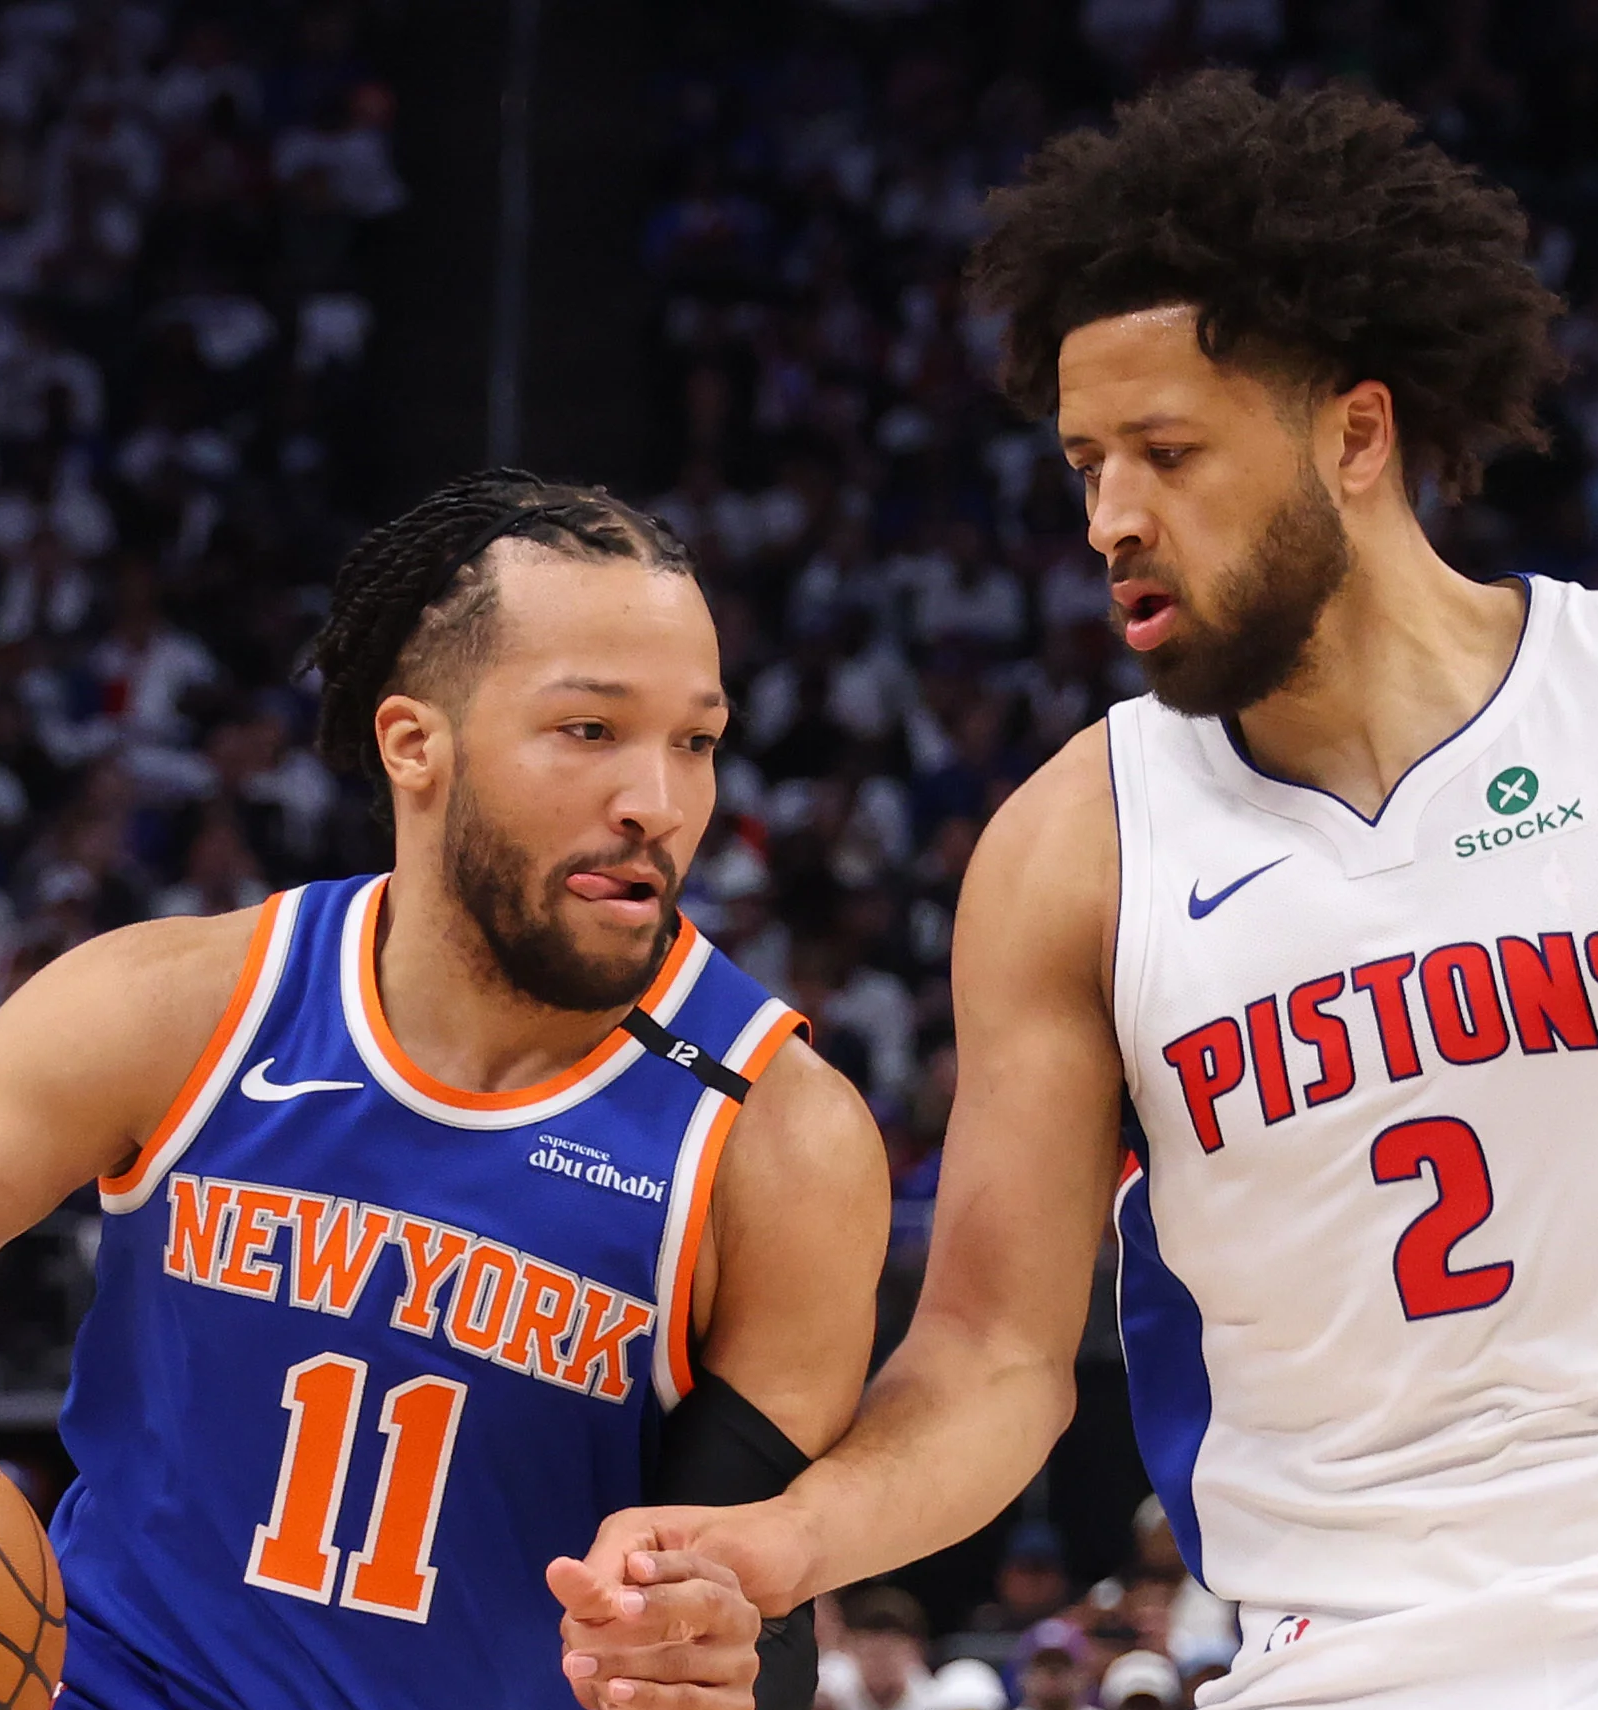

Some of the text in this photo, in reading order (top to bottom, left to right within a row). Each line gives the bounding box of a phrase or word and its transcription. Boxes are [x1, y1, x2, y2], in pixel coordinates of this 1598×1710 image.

[1454, 798, 1584, 858] StockX
[666, 1040, 700, 1068] 12
[529, 1149, 583, 1179] abu
[538, 1133, 611, 1162] experience
[1370, 1115, 1514, 1320] 2
[163, 1172, 659, 1405] NEW YORK
[243, 1352, 468, 1624] 11
